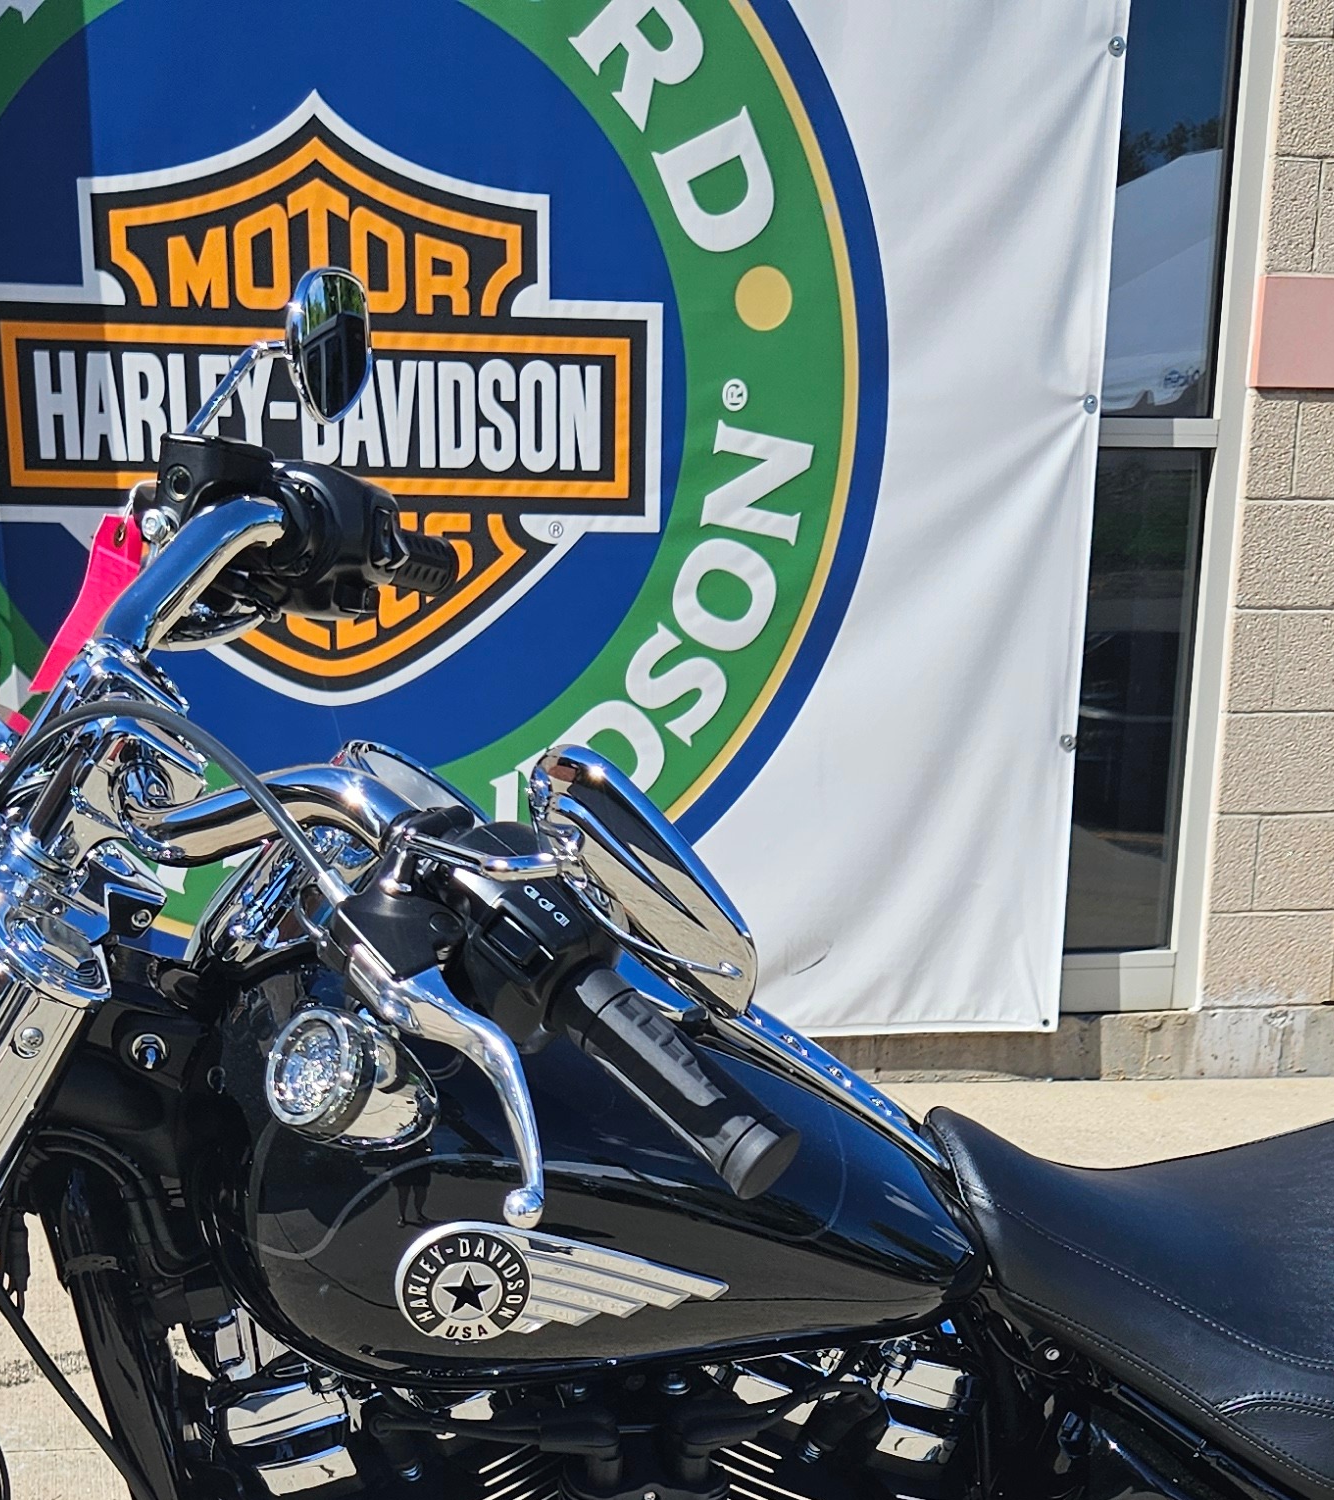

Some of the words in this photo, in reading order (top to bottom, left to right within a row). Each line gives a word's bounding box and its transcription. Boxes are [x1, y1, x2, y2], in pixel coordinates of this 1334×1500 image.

[168, 177, 469, 316] MOTOR
[408, 1237, 524, 1325] HARLEY-DAVIDSON
[445, 1325, 489, 1340] USA
